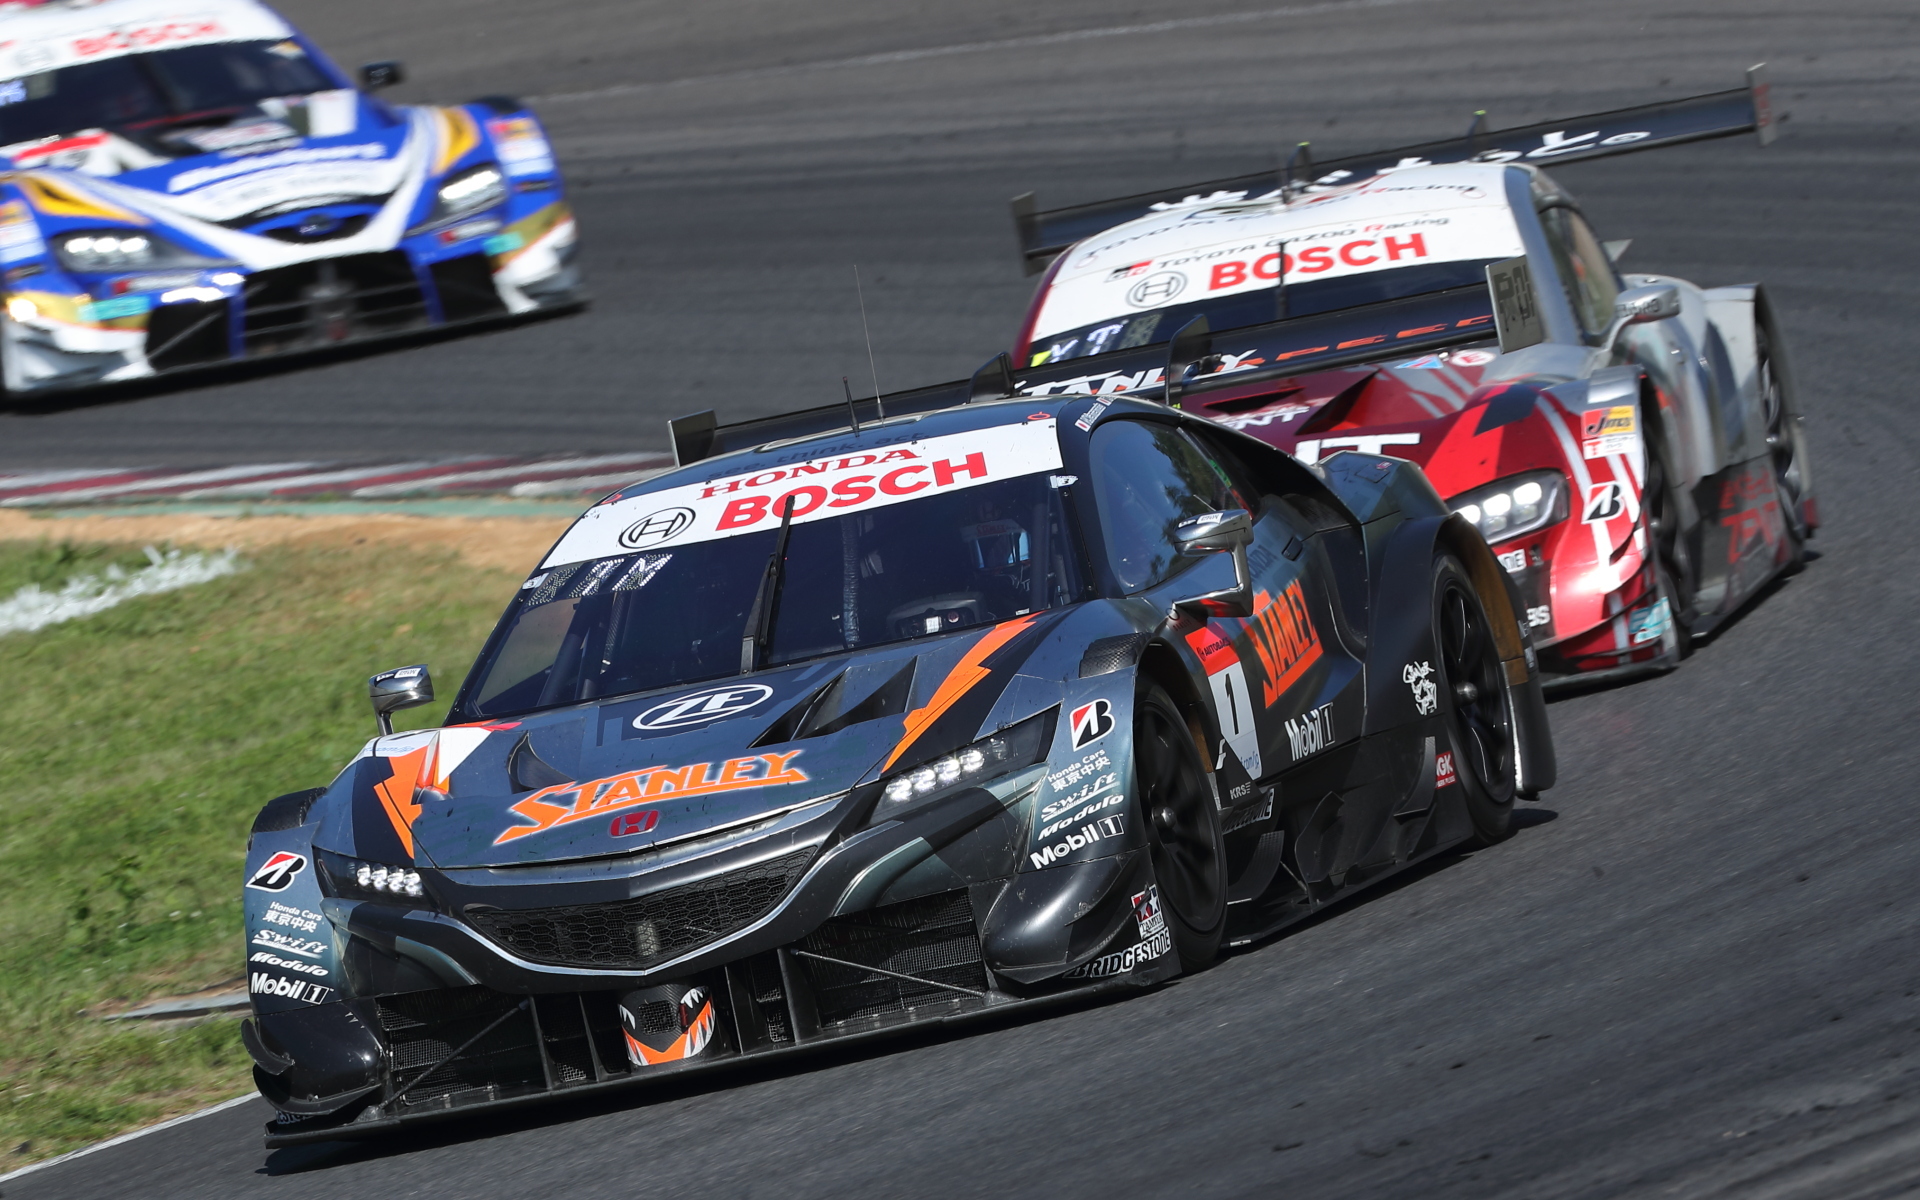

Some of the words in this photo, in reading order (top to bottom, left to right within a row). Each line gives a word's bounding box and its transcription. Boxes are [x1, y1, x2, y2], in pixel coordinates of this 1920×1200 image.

[1158, 244, 1256, 269] TOYOTA
[1362, 216, 1450, 233] Racing
[1208, 232, 1429, 292] BOSCH
[776, 442, 865, 464] think.
[875, 431, 930, 446] act.
[696, 448, 922, 500] HONDA
[715, 451, 988, 531] BOSCH
[641, 685, 766, 728] ZF
[1224, 672, 1240, 736] 1
[1284, 708, 1323, 762] Mobil
[1048, 763, 1082, 783] Honda
[1082, 749, 1106, 765] Cars
[1050, 756, 1112, 793] 東京中央
[492, 749, 809, 845] STANLEY
[1038, 794, 1124, 841] Modulo
[1030, 823, 1100, 870] Mobil
[262, 909, 318, 933] 東京中央
[270, 901, 300, 916] Honda
[301, 909, 323, 922] Cars
[249, 951, 329, 977] Modulo
[1062, 926, 1172, 978] BRIDGESTONE
[250, 972, 307, 1000] Mobil
